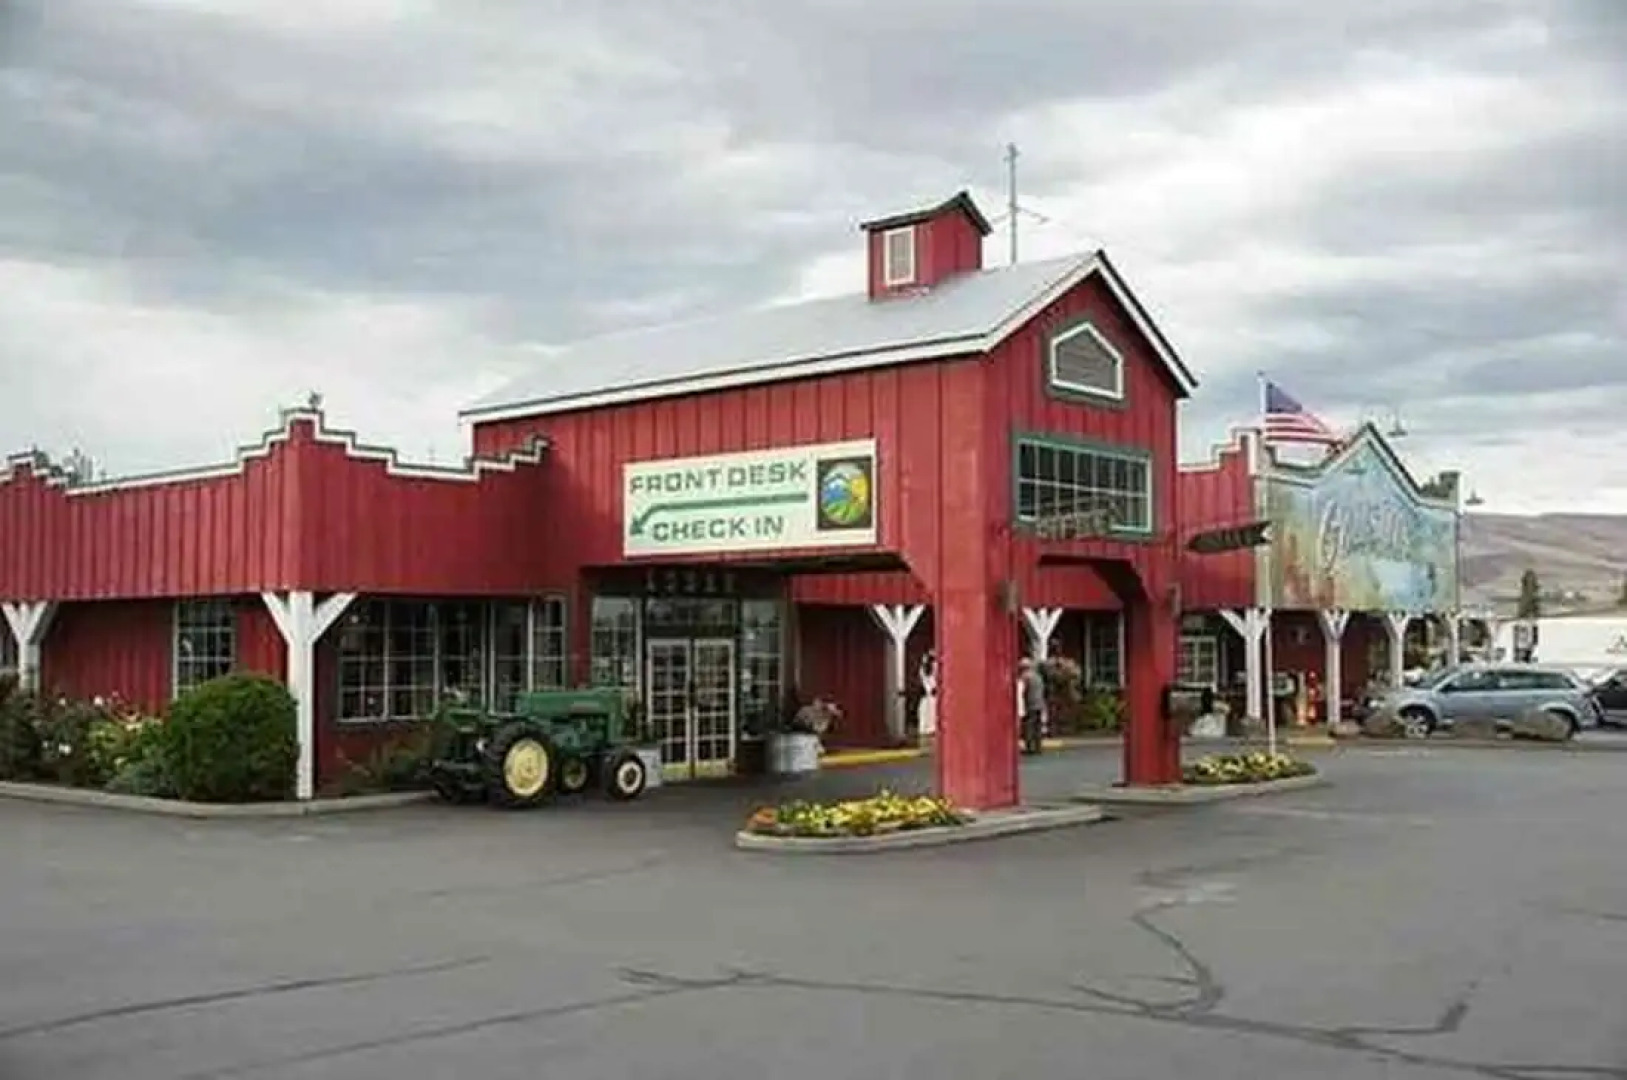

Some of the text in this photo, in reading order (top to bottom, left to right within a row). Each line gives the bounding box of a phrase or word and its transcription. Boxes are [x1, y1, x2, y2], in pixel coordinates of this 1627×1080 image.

[629, 462, 808, 494] FRONT DESK
[653, 516, 784, 542] CHECK IN
